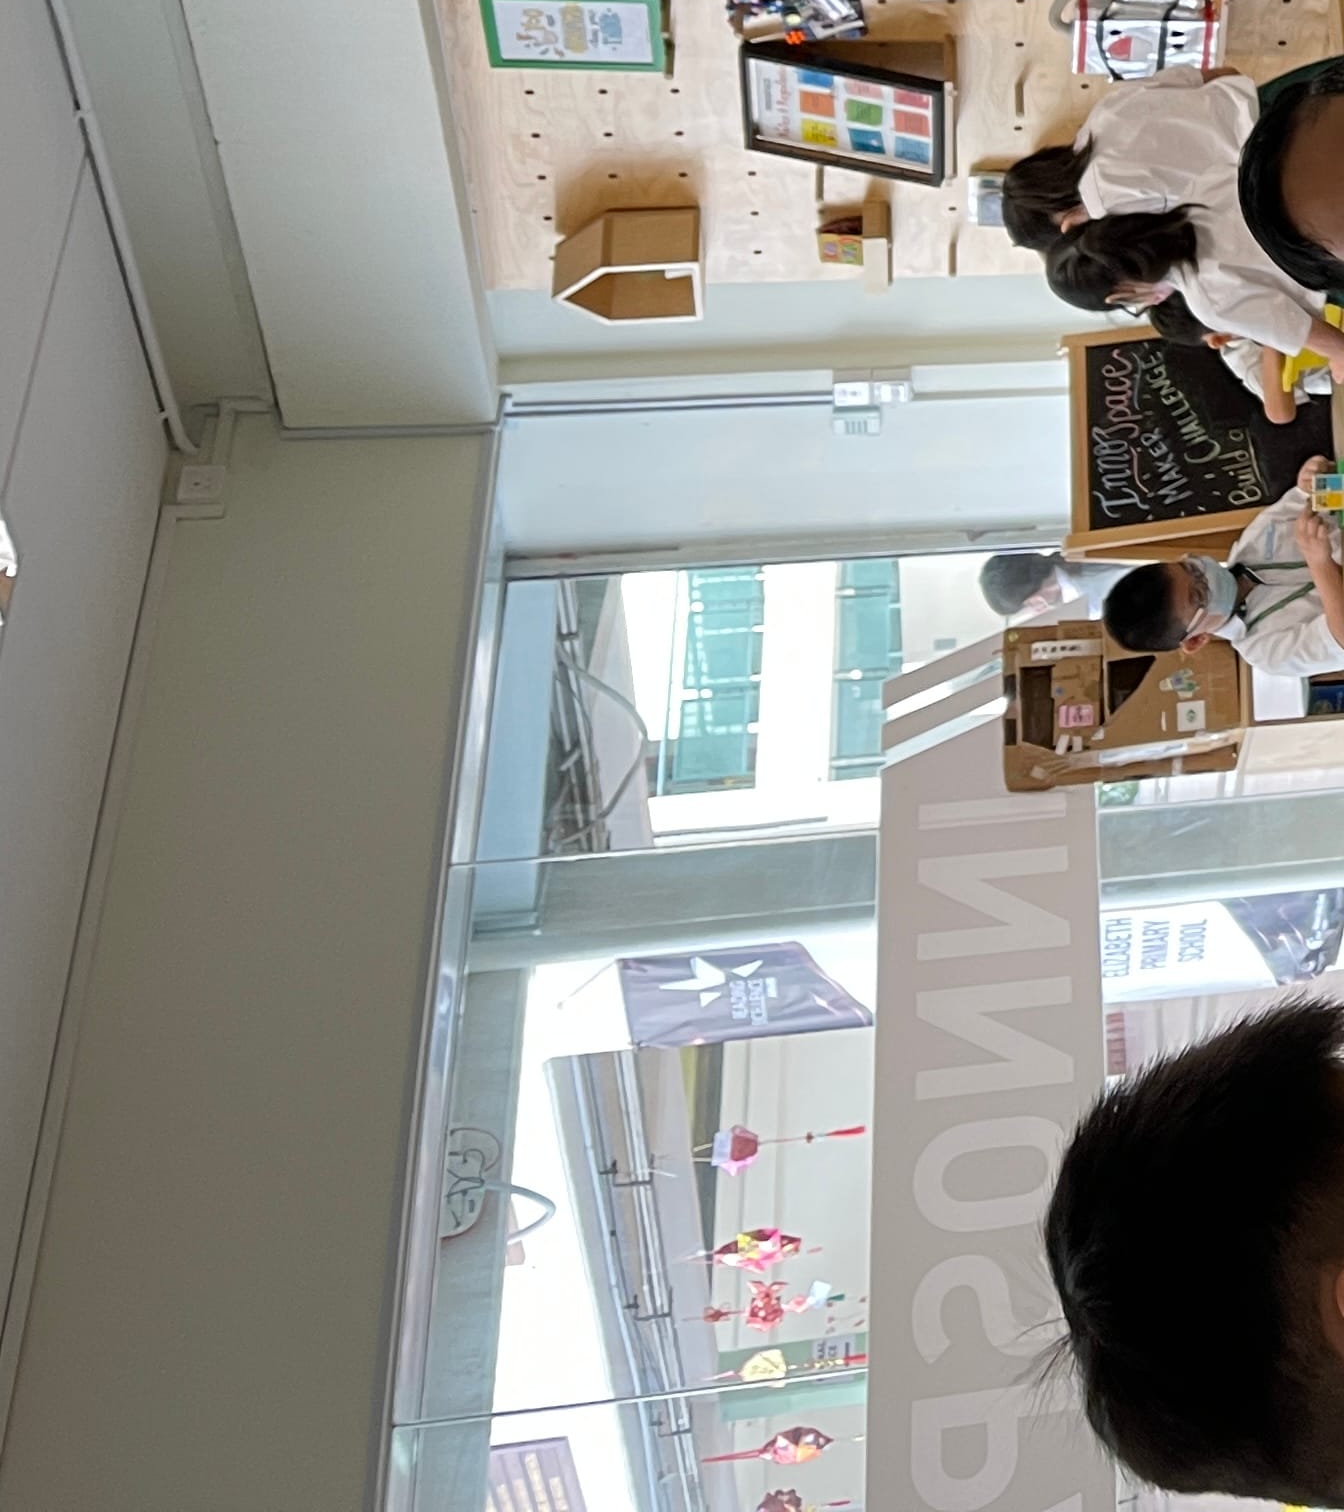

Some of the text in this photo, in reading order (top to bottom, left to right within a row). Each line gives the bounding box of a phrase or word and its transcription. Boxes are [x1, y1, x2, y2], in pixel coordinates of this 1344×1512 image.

[1140, 351, 1221, 464] CHALLENGE
[1140, 427, 1193, 505] MAKER
[1218, 450, 1262, 506] Build
[1102, 918, 1132, 978] ELIZABETH
[1140, 920, 1170, 970] PRIMARY
[1178, 918, 1207, 962] SCHOOL
